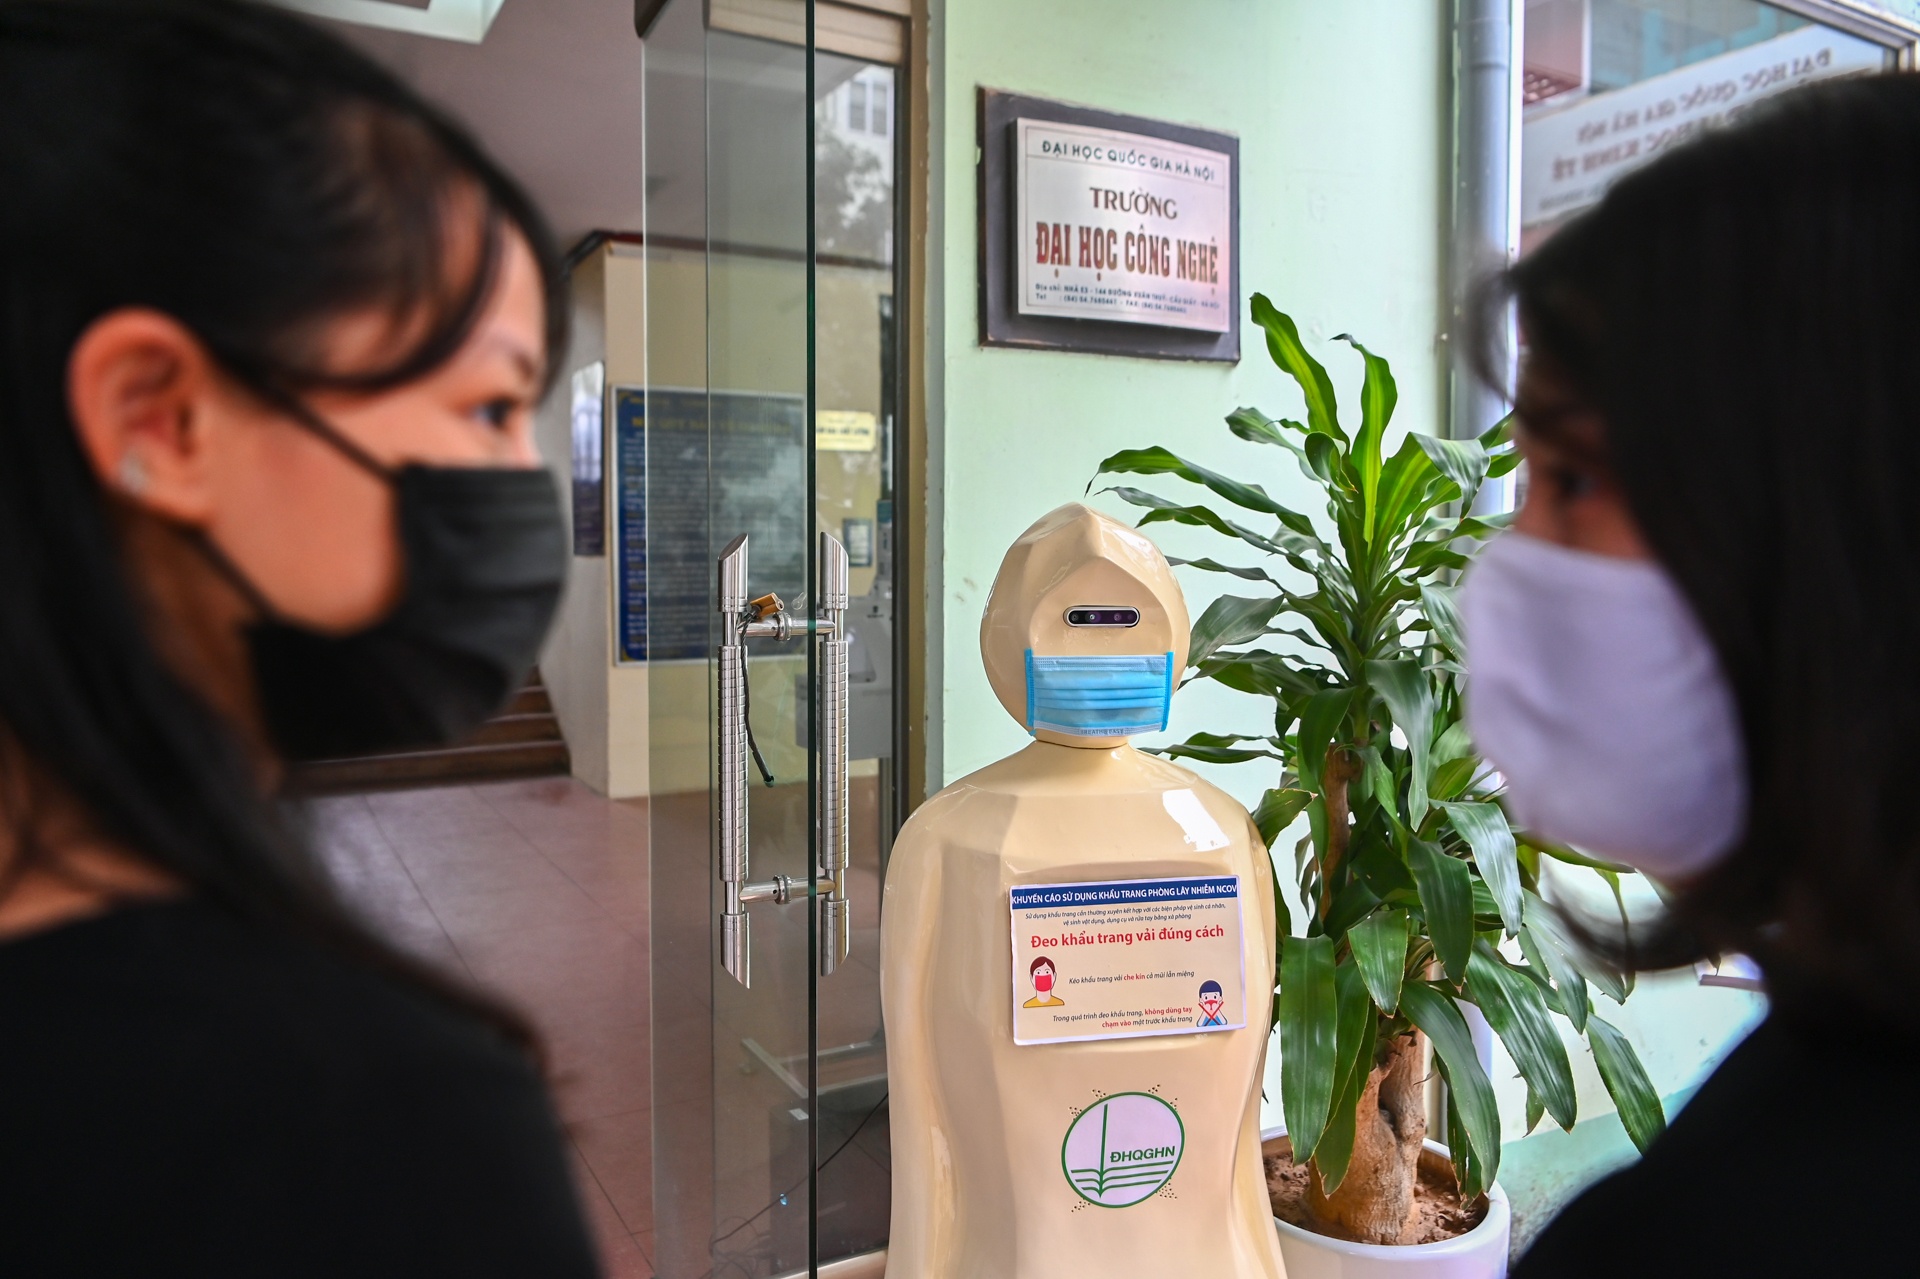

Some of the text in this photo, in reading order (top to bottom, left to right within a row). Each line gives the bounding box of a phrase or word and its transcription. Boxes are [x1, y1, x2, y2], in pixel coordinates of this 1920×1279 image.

[1042, 140, 1215, 181] ĐẠI HỌC QUỐC GIA HÀ NỘI
[1089, 187, 1178, 220] TRƯỜNG
[1036, 221, 1218, 296] ĐẠI HỌC CÔNG NGHỆ
[1095, 287, 1106, 295] 144
[1012, 884, 1237, 904] KHUYẾN CÁO SỬ DỤNG KHẨU TRANG PHÒNG LÂY NHIỄM NCOV
[1047, 910, 1061, 918] khẩu
[1062, 911, 1076, 919] trang
[1087, 909, 1106, 917] thường
[1107, 908, 1122, 916] xuyên
[1132, 907, 1142, 915] hợp
[1173, 905, 1186, 913] pháp
[1090, 917, 1105, 925] dụng,
[1106, 916, 1120, 924] dụng
[1174, 913, 1191, 921] phòng
[1031, 924, 1224, 948] Đeo khẩu trang vải đúng cách
[1069, 977, 1080, 985] Kéo
[1081, 975, 1096, 984] khẩu
[1123, 973, 1135, 981] che
[1135, 972, 1146, 980] kín
[1154, 971, 1165, 979] mũi
[1176, 970, 1195, 978] miệng
[1053, 1006, 1193, 1023] Trong quá trình đeo khẩu trang, không dùng tay
[1102, 1021, 1119, 1029] chạm
[1132, 1018, 1144, 1027] mặt
[1145, 1017, 1161, 1025] trước
[1161, 1015, 1177, 1024] khẩu
[1177, 1015, 1193, 1024] trang
[1110, 1146, 1176, 1163] ĐHQGHN
